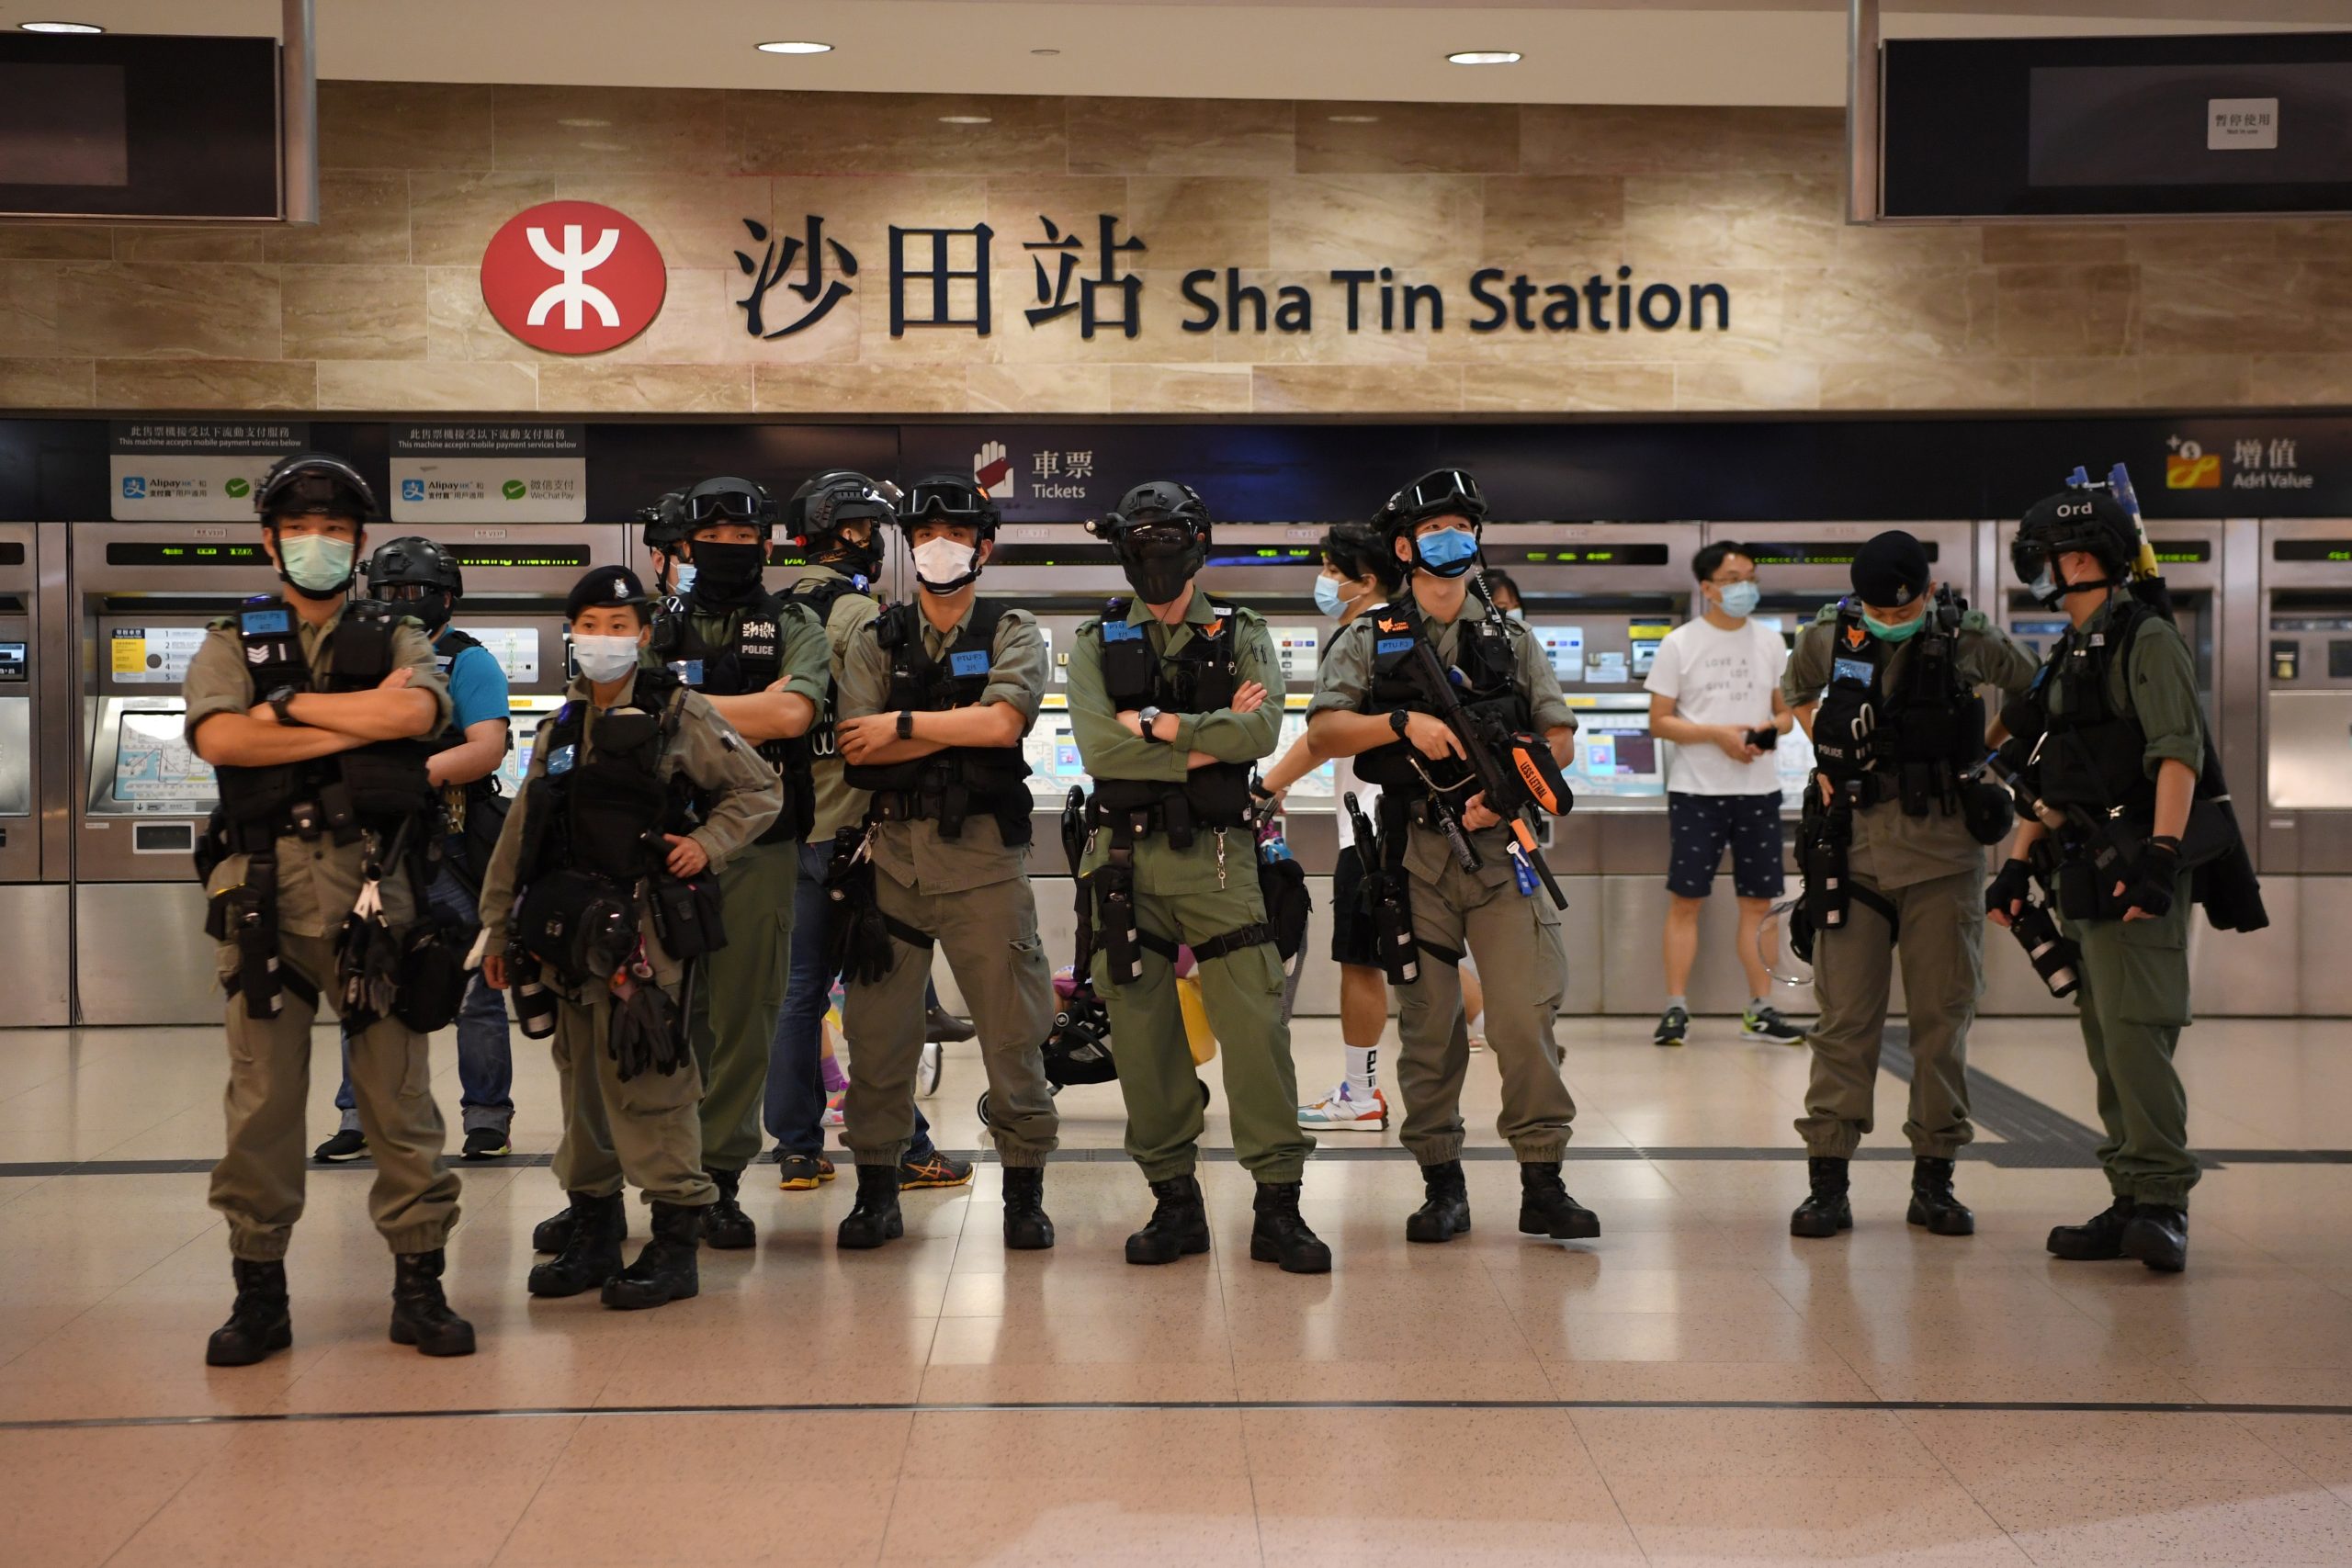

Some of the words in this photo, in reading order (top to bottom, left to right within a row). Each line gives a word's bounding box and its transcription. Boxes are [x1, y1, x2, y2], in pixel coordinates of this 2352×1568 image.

[733, 214, 1147, 339] 沙田站
[1182, 266, 1311, 333] Sha
[1331, 266, 1443, 332] Tin
[1469, 265, 1729, 333] Station
[410, 428, 565, 440] 此售票機接受以下流動支付服務
[119, 437, 133, 446] This
[166, 439, 192, 447] accepts
[194, 438, 218, 446] mobile
[220, 440, 250, 448] payment
[399, 440, 413, 448] This
[444, 441, 469, 450] accepts
[496, 441, 526, 450] payment
[2233, 437, 2297, 468] 增值
[1032, 450, 1093, 479] 車票
[530, 479, 573, 491] 微信支付
[2233, 472, 2266, 489] Add
[2268, 472, 2314, 489] Value
[530, 491, 560, 500] WeChat
[561, 491, 573, 501] Pay
[1032, 483, 1086, 498] Tickets
[2056, 502, 2093, 517] Ord
[741, 644, 774, 655] POLICE
[1704, 658, 1732, 669] LOVE
[1729, 669, 1749, 679] LOT
[1705, 681, 1730, 692] GIVE
[1747, 681, 1754, 690] A
[1729, 691, 1749, 702] LOT
[1817, 743, 1843, 759] POLICE
[1520, 761, 1534, 779] LESS
[1528, 775, 1547, 799] LETHAL
